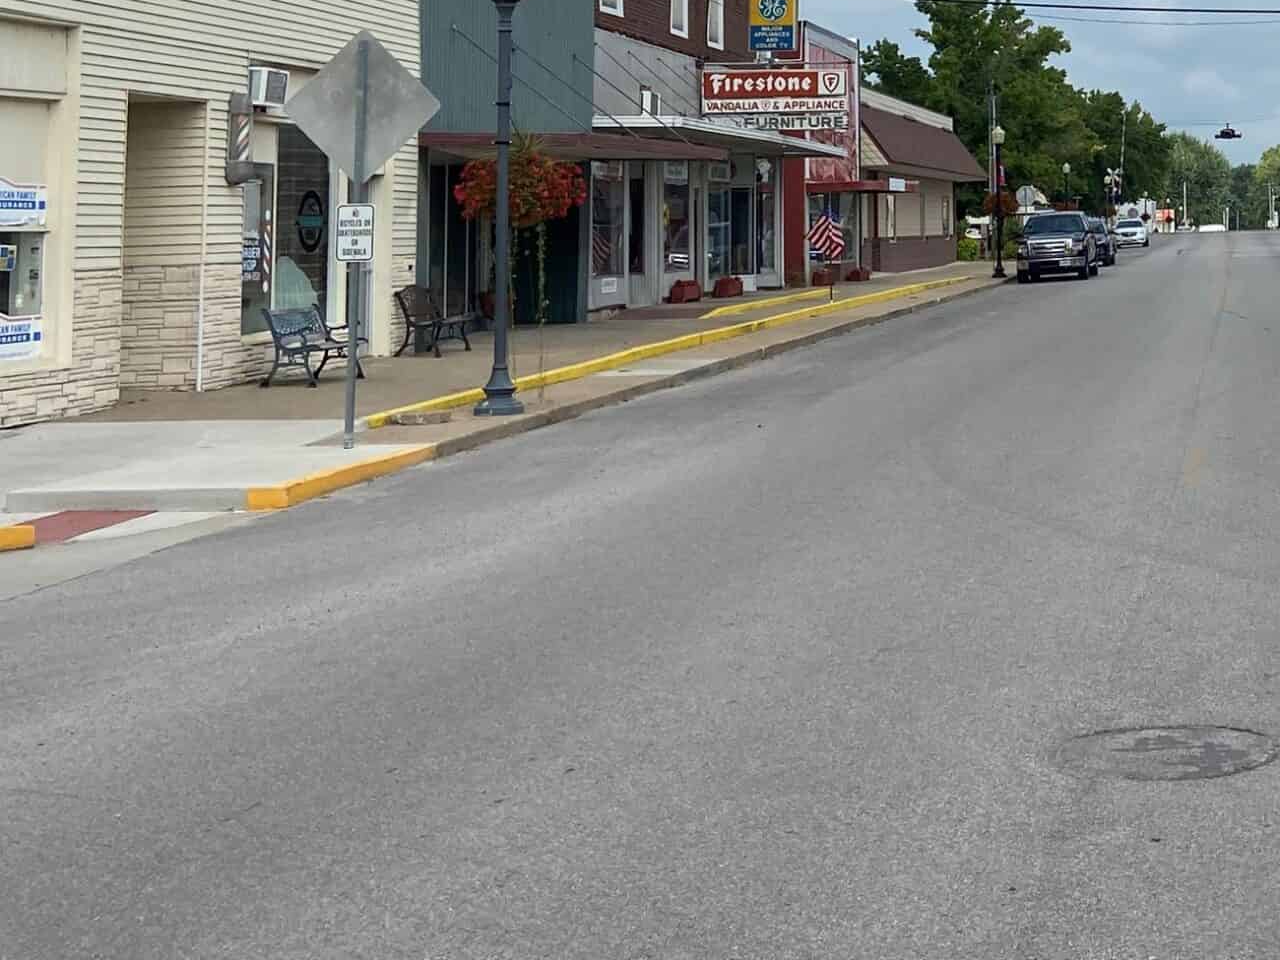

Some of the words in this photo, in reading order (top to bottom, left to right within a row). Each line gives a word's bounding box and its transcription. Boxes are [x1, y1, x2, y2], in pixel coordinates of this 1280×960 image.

[709, 73, 812, 94] Firestone
[706, 101, 759, 111] VANDALIA
[773, 100, 779, 110] &
[784, 100, 845, 111] APPLIANCE
[744, 116, 843, 128] FURNITURE
